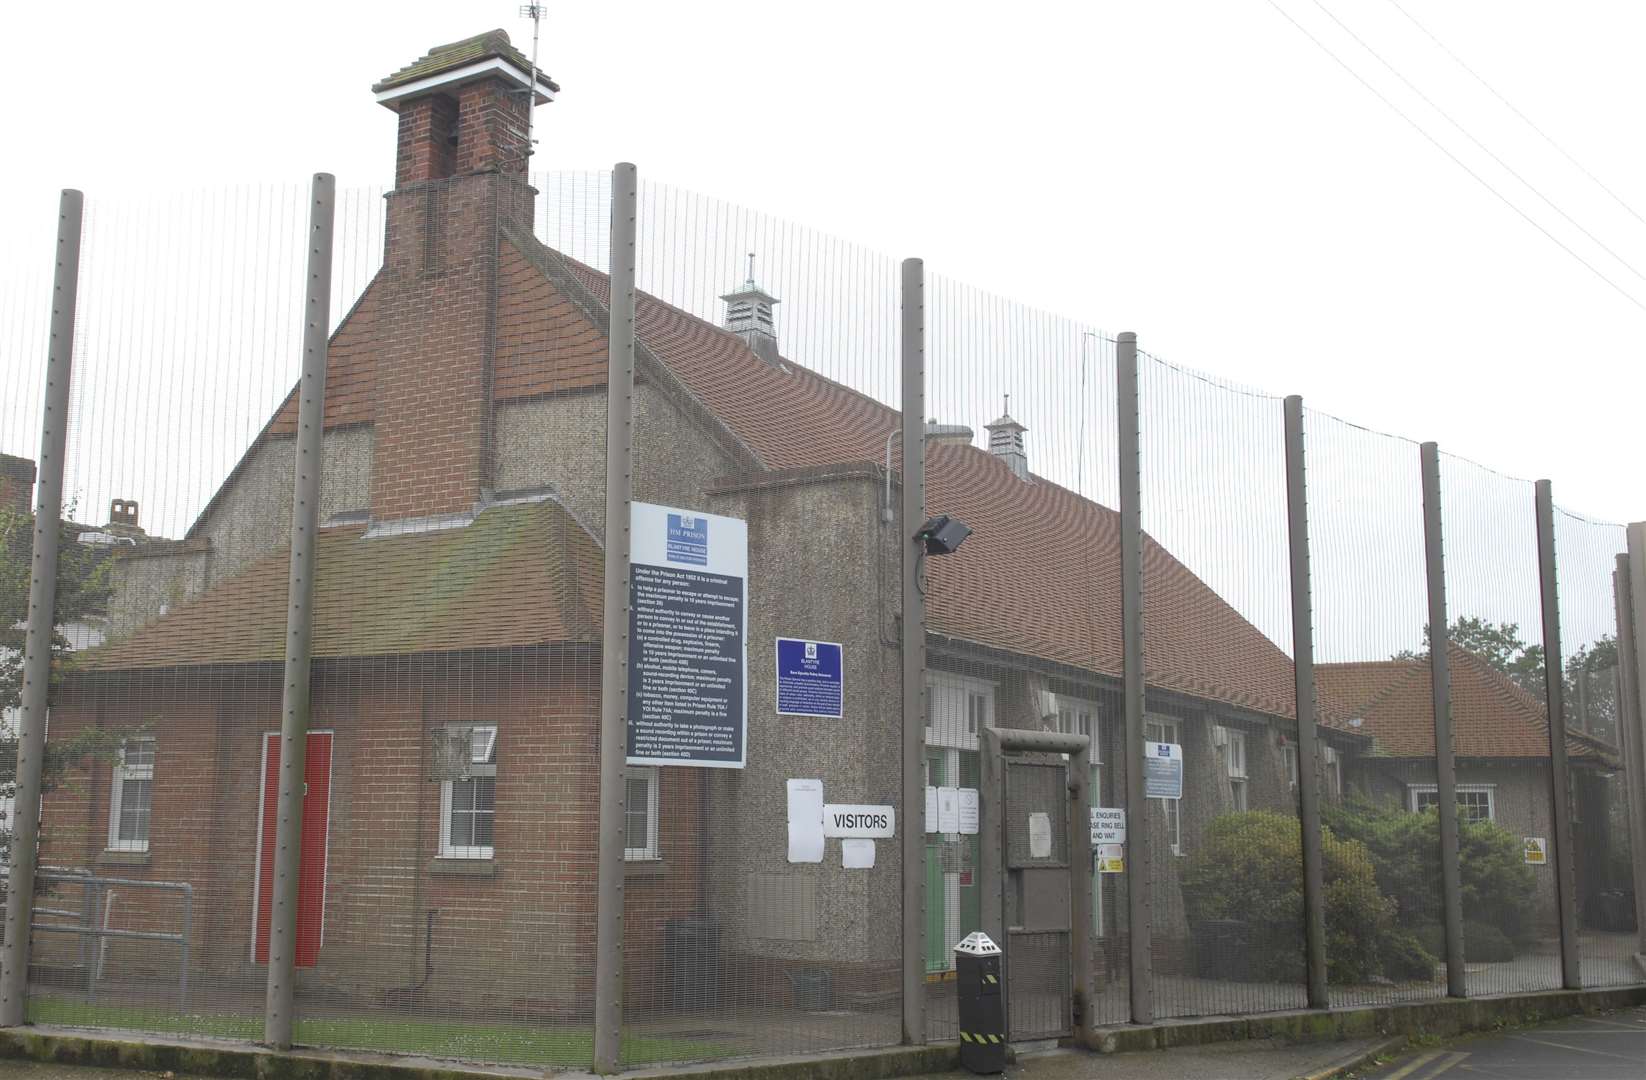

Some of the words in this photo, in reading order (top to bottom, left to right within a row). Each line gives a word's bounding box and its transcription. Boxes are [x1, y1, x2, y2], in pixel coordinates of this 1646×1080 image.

[683, 529, 705, 540] PRISON
[834, 814, 887, 829] VISITORS
[1101, 822, 1113, 830] RING
[1114, 822, 1124, 830] BELL
[1104, 832, 1115, 840] WAIT
